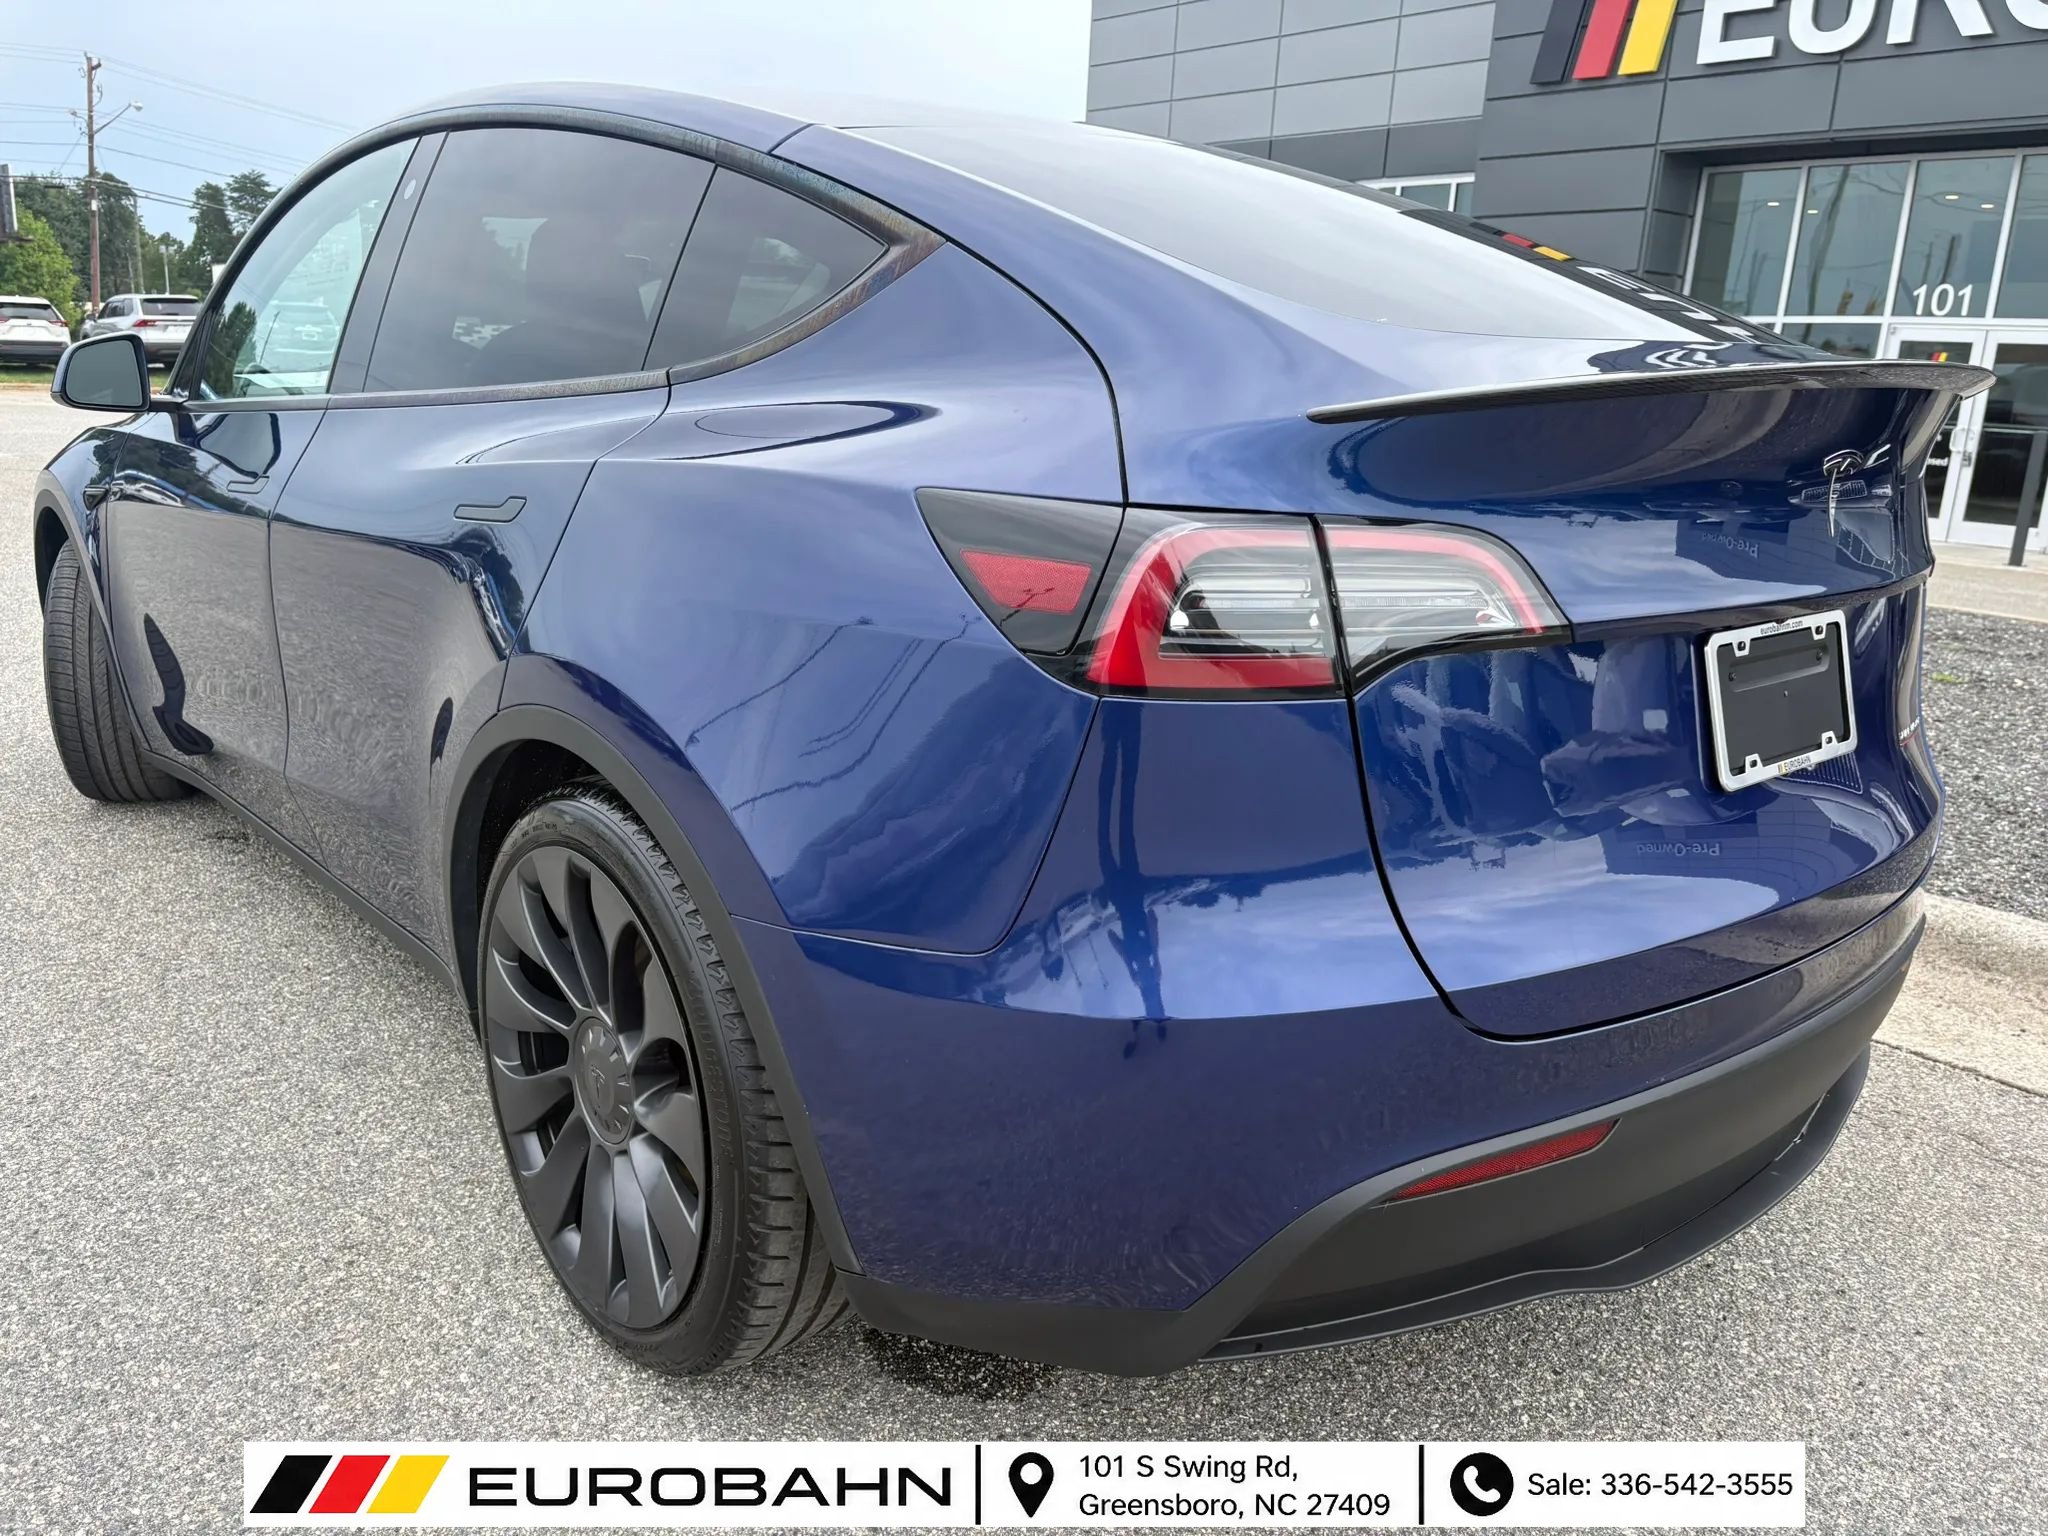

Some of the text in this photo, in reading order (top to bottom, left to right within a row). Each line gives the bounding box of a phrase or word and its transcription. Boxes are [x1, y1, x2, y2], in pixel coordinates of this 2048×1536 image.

[1696, 0, 2048, 64] EU
[1912, 283, 1973, 316] 101
[1636, 842, 1720, 857] Pre-Owned
